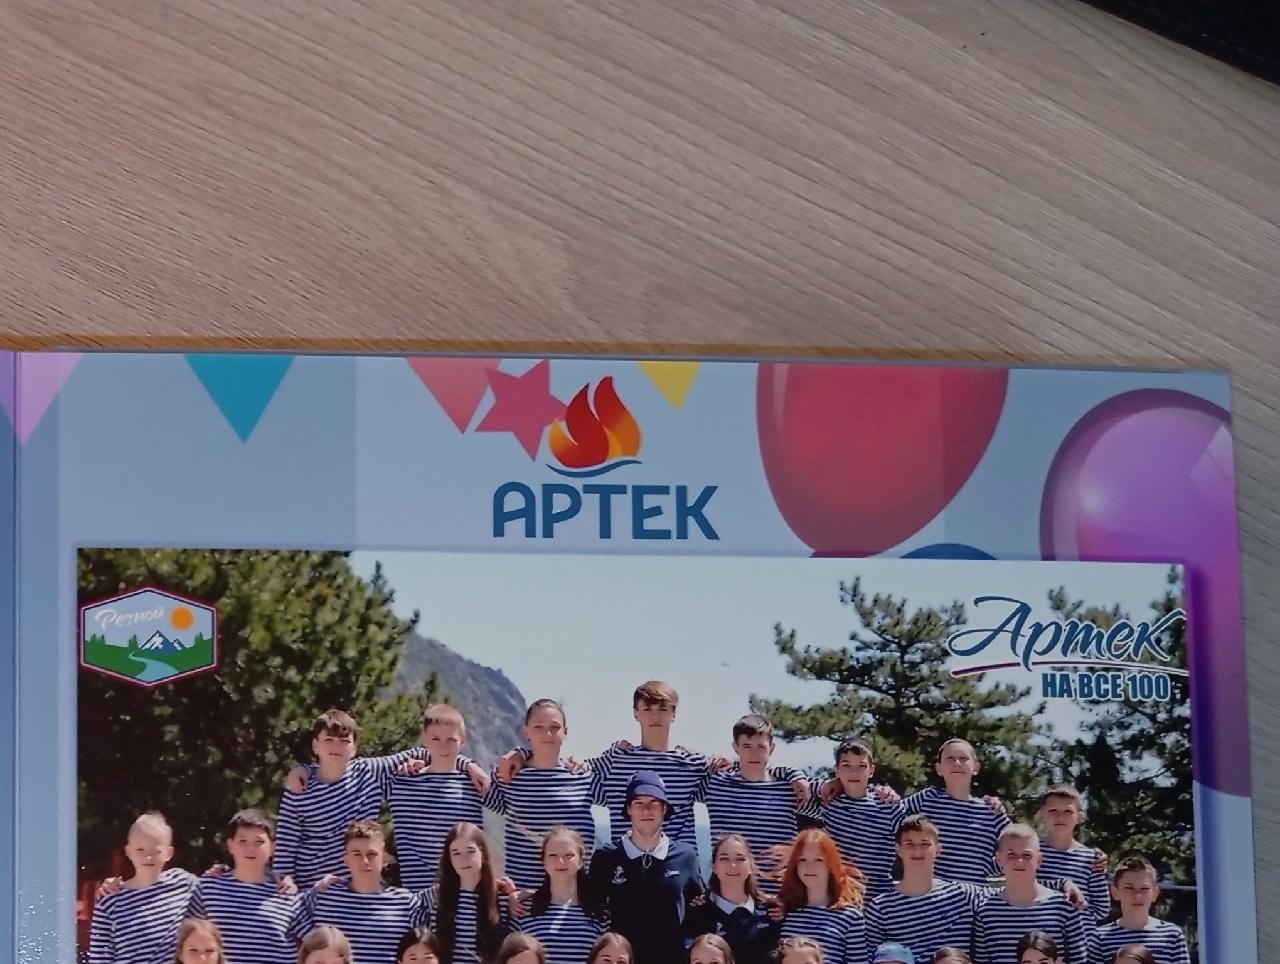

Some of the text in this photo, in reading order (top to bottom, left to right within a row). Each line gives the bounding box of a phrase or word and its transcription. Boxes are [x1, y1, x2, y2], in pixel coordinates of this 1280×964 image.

[493, 481, 721, 540] АРТЕК
[944, 595, 1188, 672] Артек
[1041, 672, 1171, 701] НА ВСЕ 100
